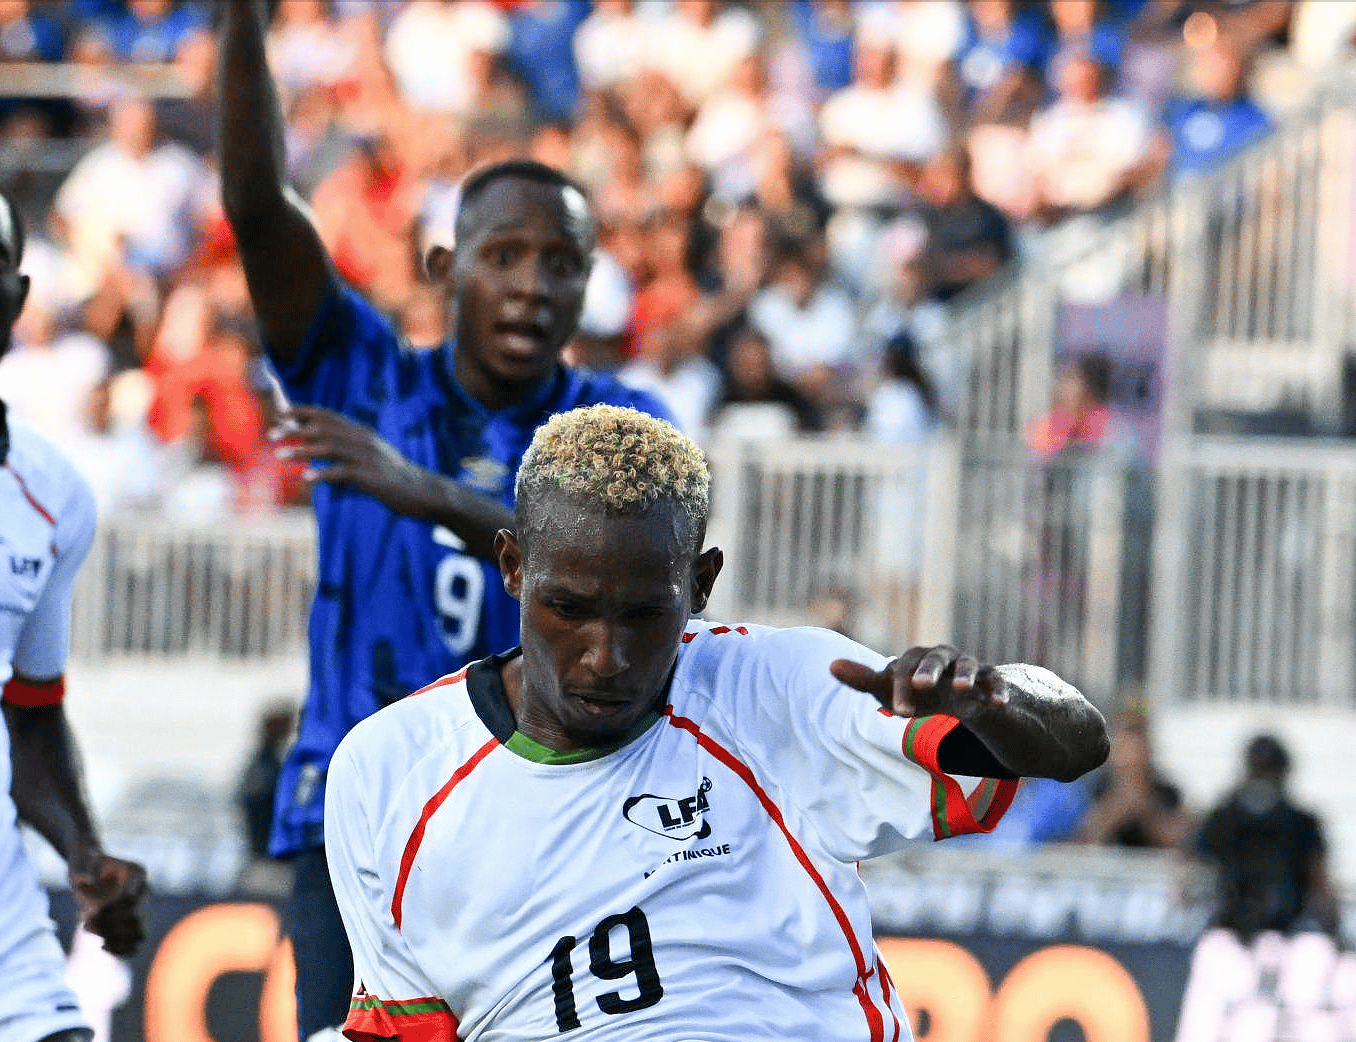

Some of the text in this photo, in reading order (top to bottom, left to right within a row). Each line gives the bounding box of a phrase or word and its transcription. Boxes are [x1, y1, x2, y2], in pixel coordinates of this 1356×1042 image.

[434, 553, 485, 656] 9
[643, 844, 731, 880] TINIQUE
[551, 906, 664, 1033] 19
